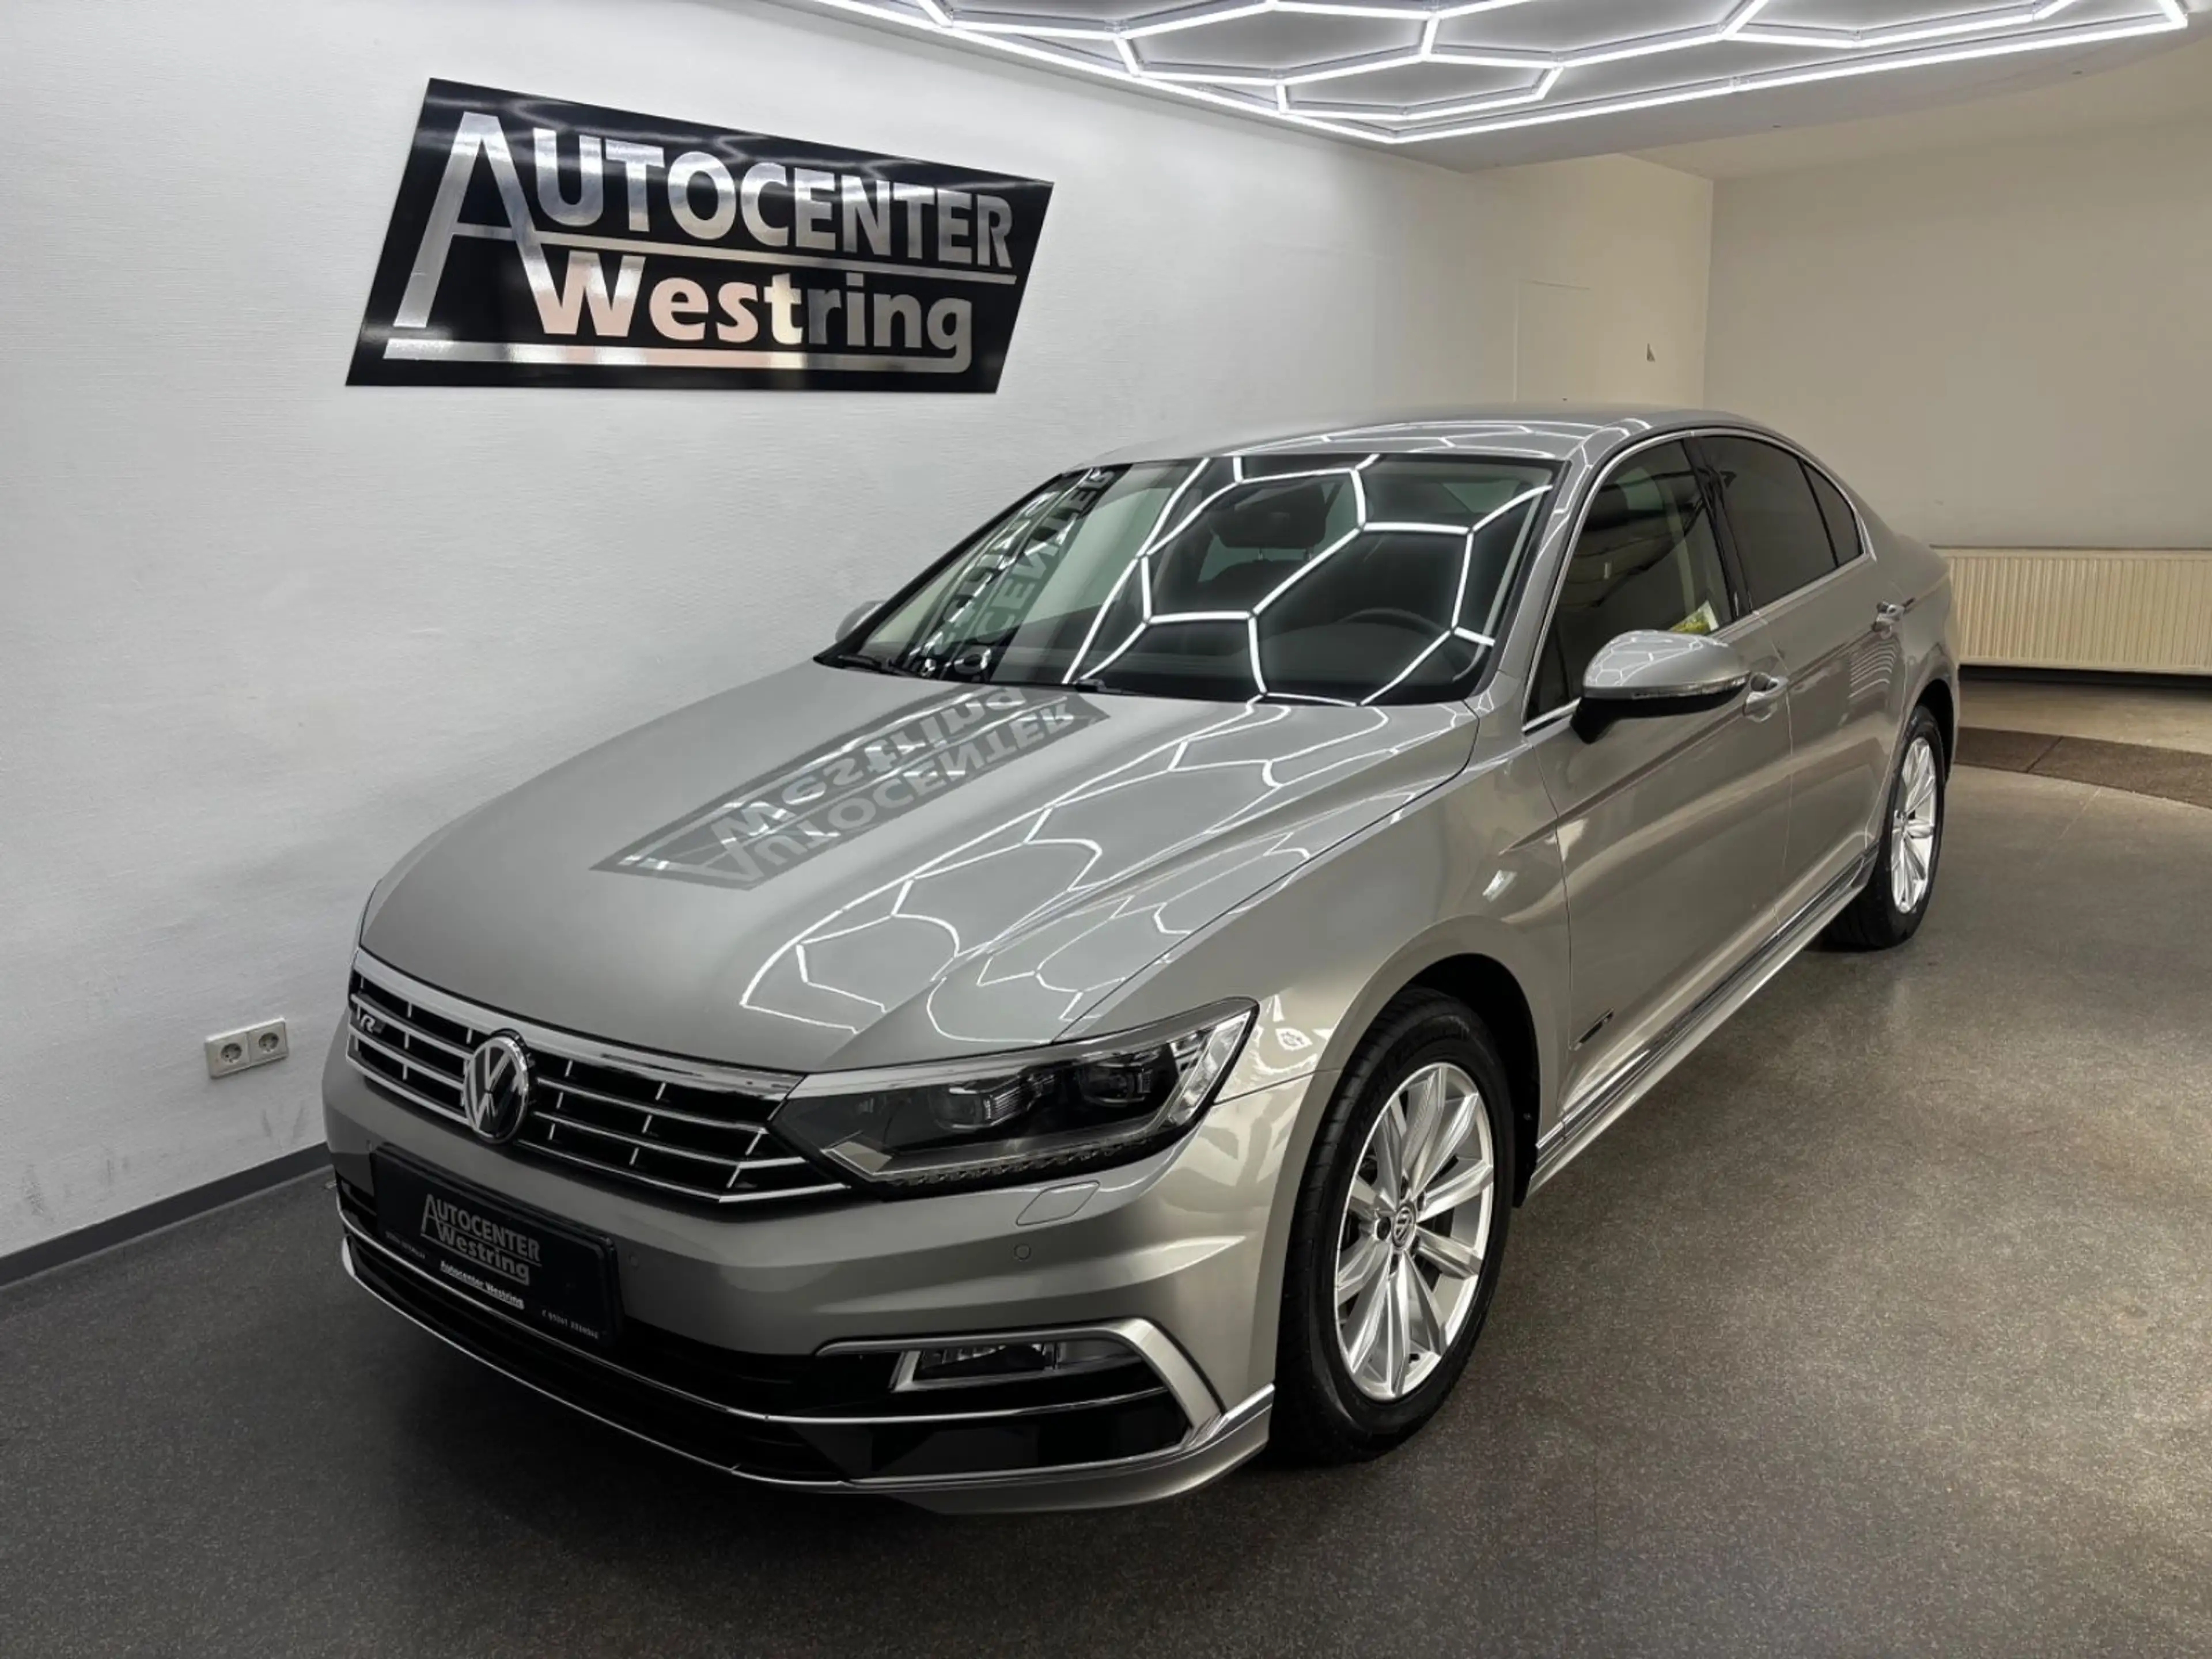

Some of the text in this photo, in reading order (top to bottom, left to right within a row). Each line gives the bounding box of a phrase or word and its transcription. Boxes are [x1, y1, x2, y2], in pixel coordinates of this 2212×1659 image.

[394, 111, 1014, 329] AUTOCENTER
[535, 249, 972, 373] Westring
[421, 1193, 541, 1262] AUTOCENTER
[438, 1223, 531, 1286] Westring
